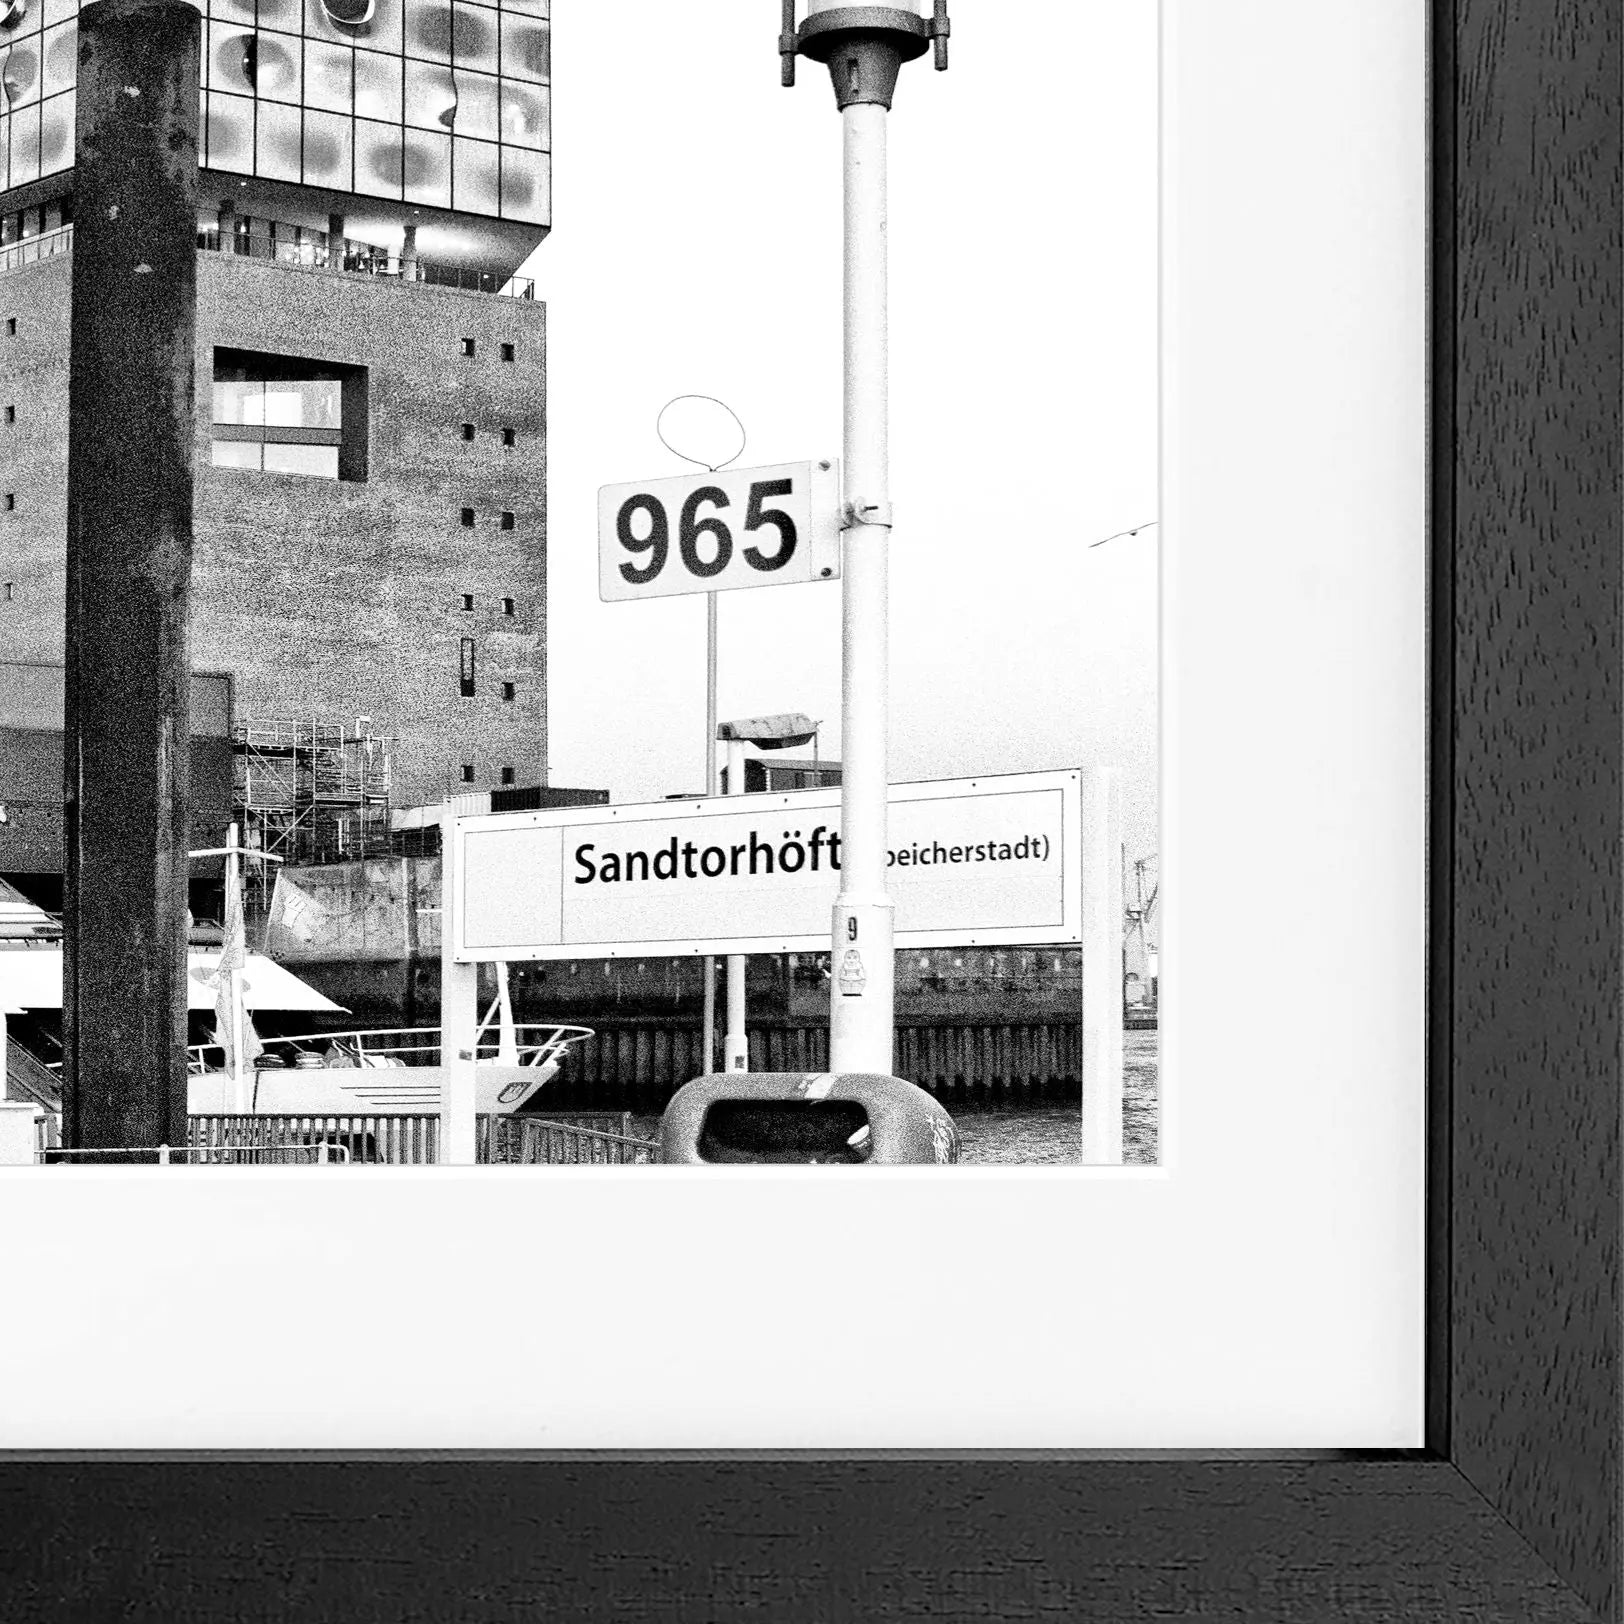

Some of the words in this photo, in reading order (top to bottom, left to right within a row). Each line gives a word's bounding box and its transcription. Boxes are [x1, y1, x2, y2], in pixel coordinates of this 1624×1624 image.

[616, 478, 797, 584] 965
[575, 826, 842, 884] Sandtorhöft
[847, 916, 858, 941] 9
